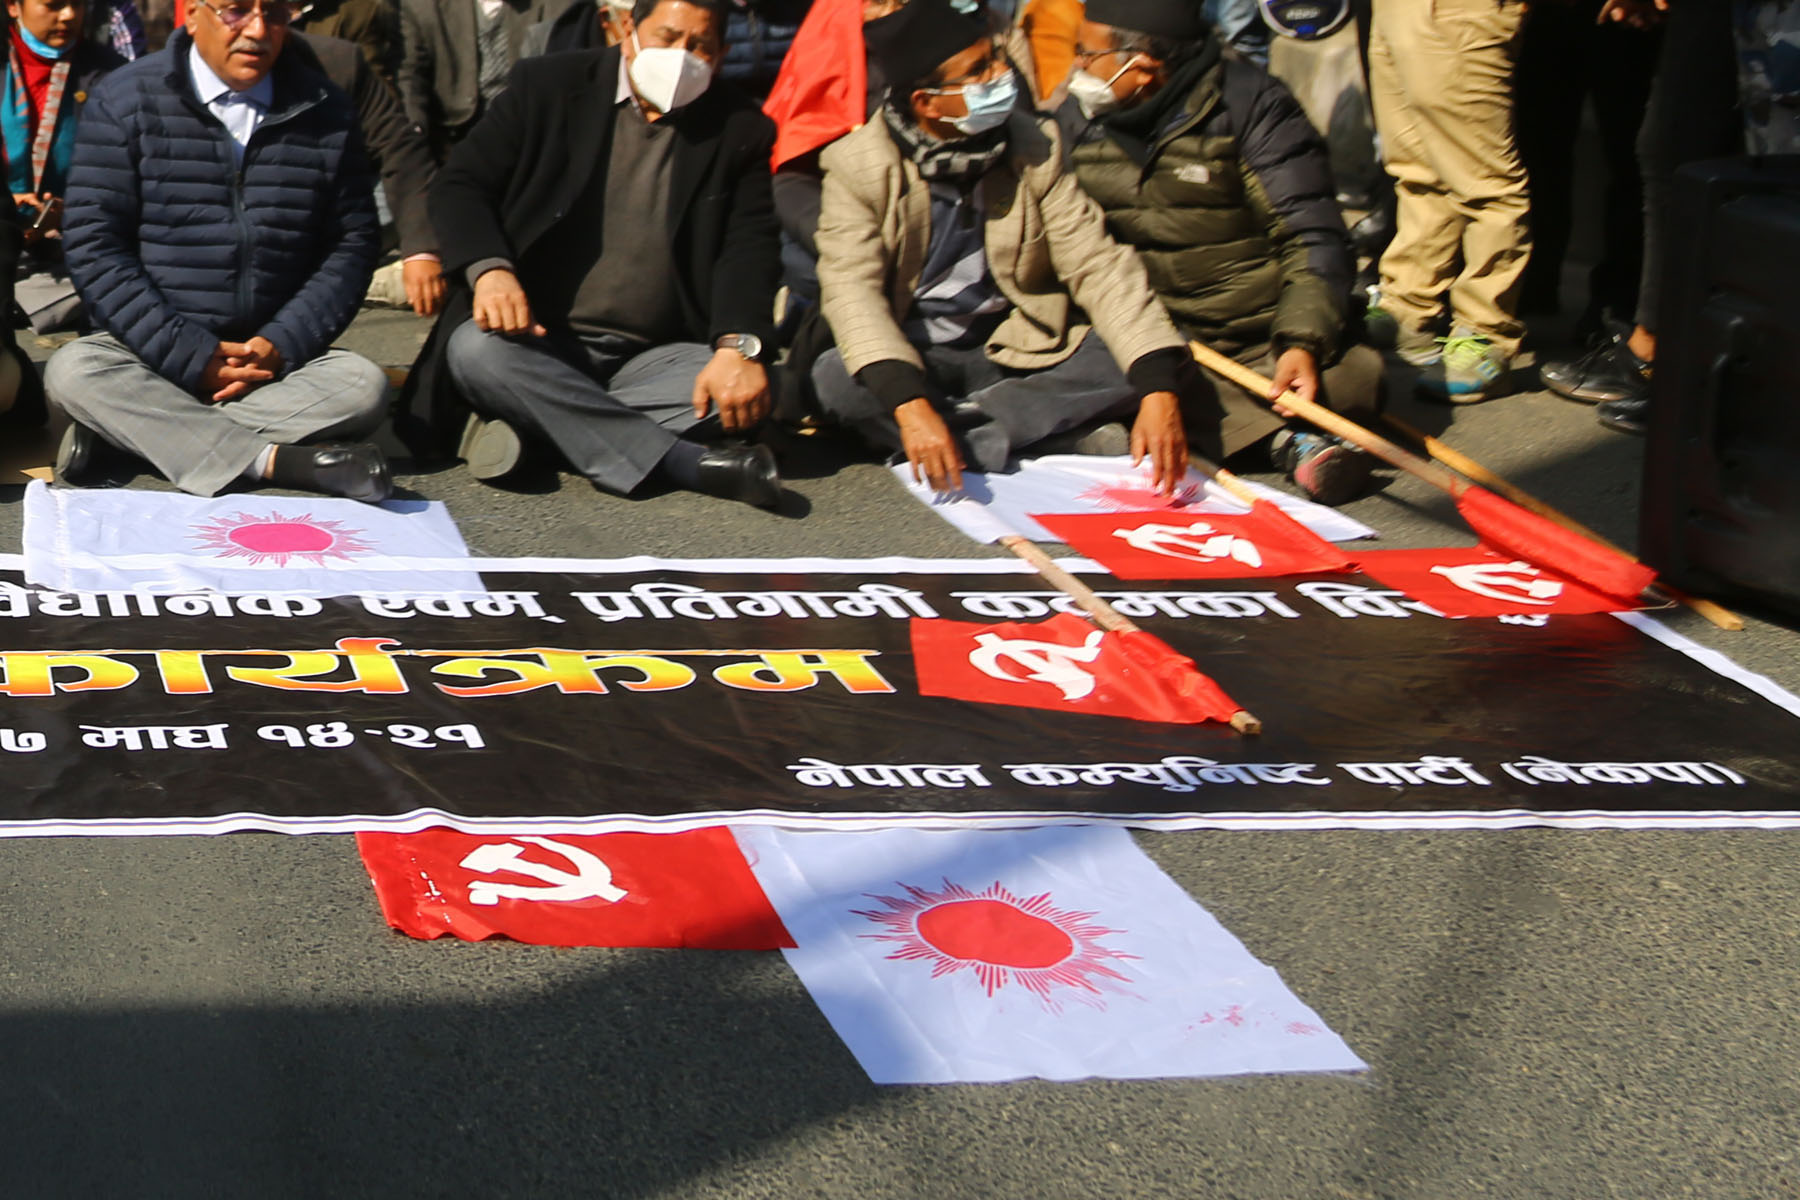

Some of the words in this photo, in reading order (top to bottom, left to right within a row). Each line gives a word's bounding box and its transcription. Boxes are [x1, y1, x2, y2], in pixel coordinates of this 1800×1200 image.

[571, 583, 940, 620] प्रतिगामी
[78, 723, 230, 751] माघ
[786, 757, 993, 788] नेपाल
[1501, 756, 1748, 787] (नेकपा)
